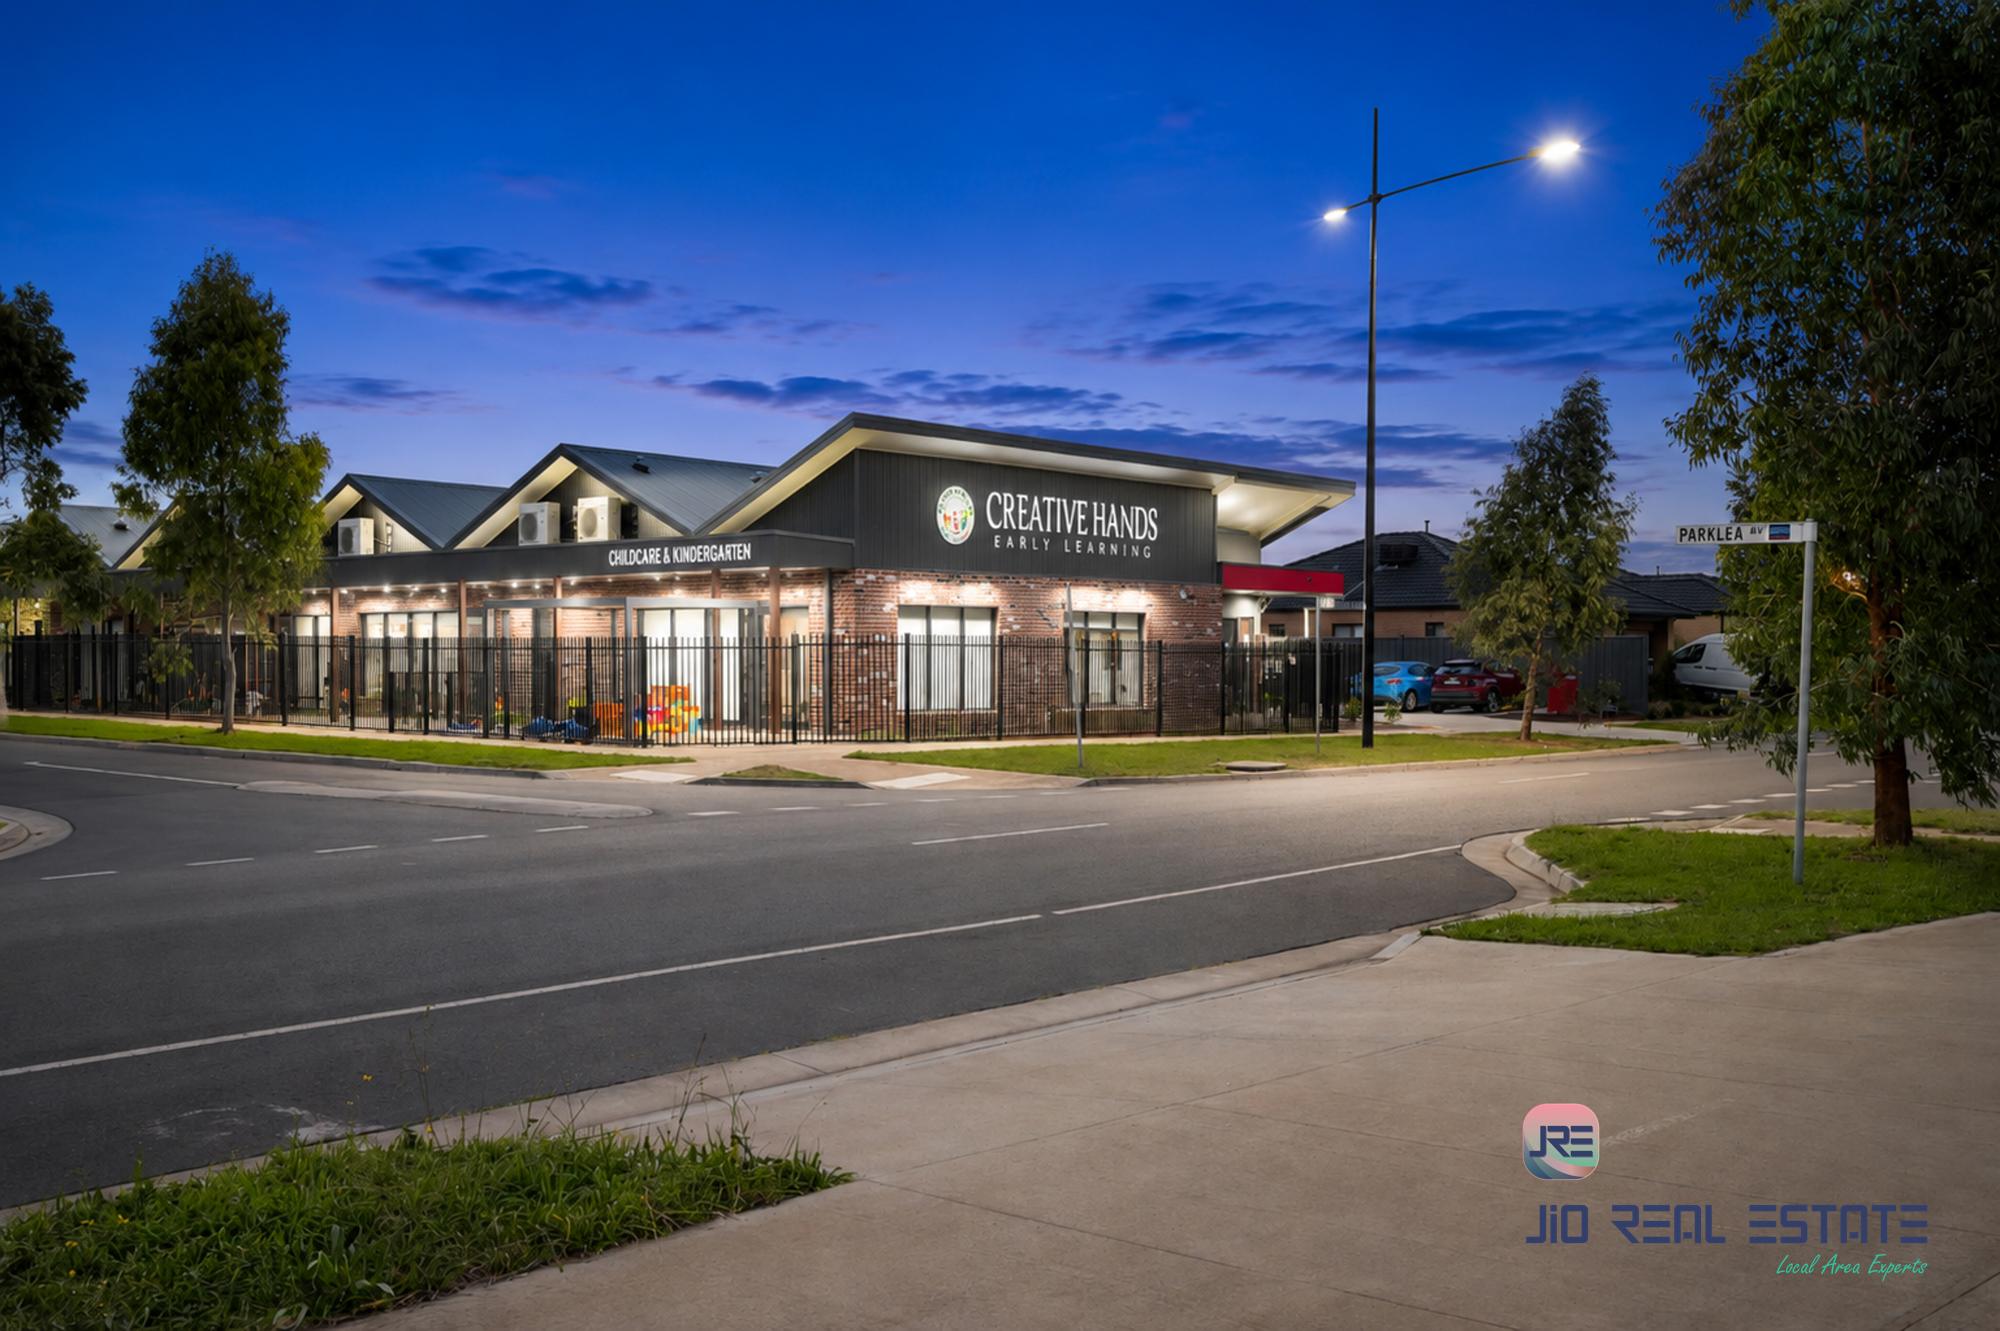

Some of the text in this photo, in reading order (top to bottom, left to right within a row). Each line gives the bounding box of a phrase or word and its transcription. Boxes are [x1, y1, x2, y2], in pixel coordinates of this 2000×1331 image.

[986, 491, 1088, 535] CREATIVE
[1093, 501, 1158, 541] HANDS
[1679, 526, 1743, 542] PARKLEA
[608, 542, 751, 567] CHILDCARE & KINDERGARTEN
[994, 535, 1151, 559] EARLY LEARNING
